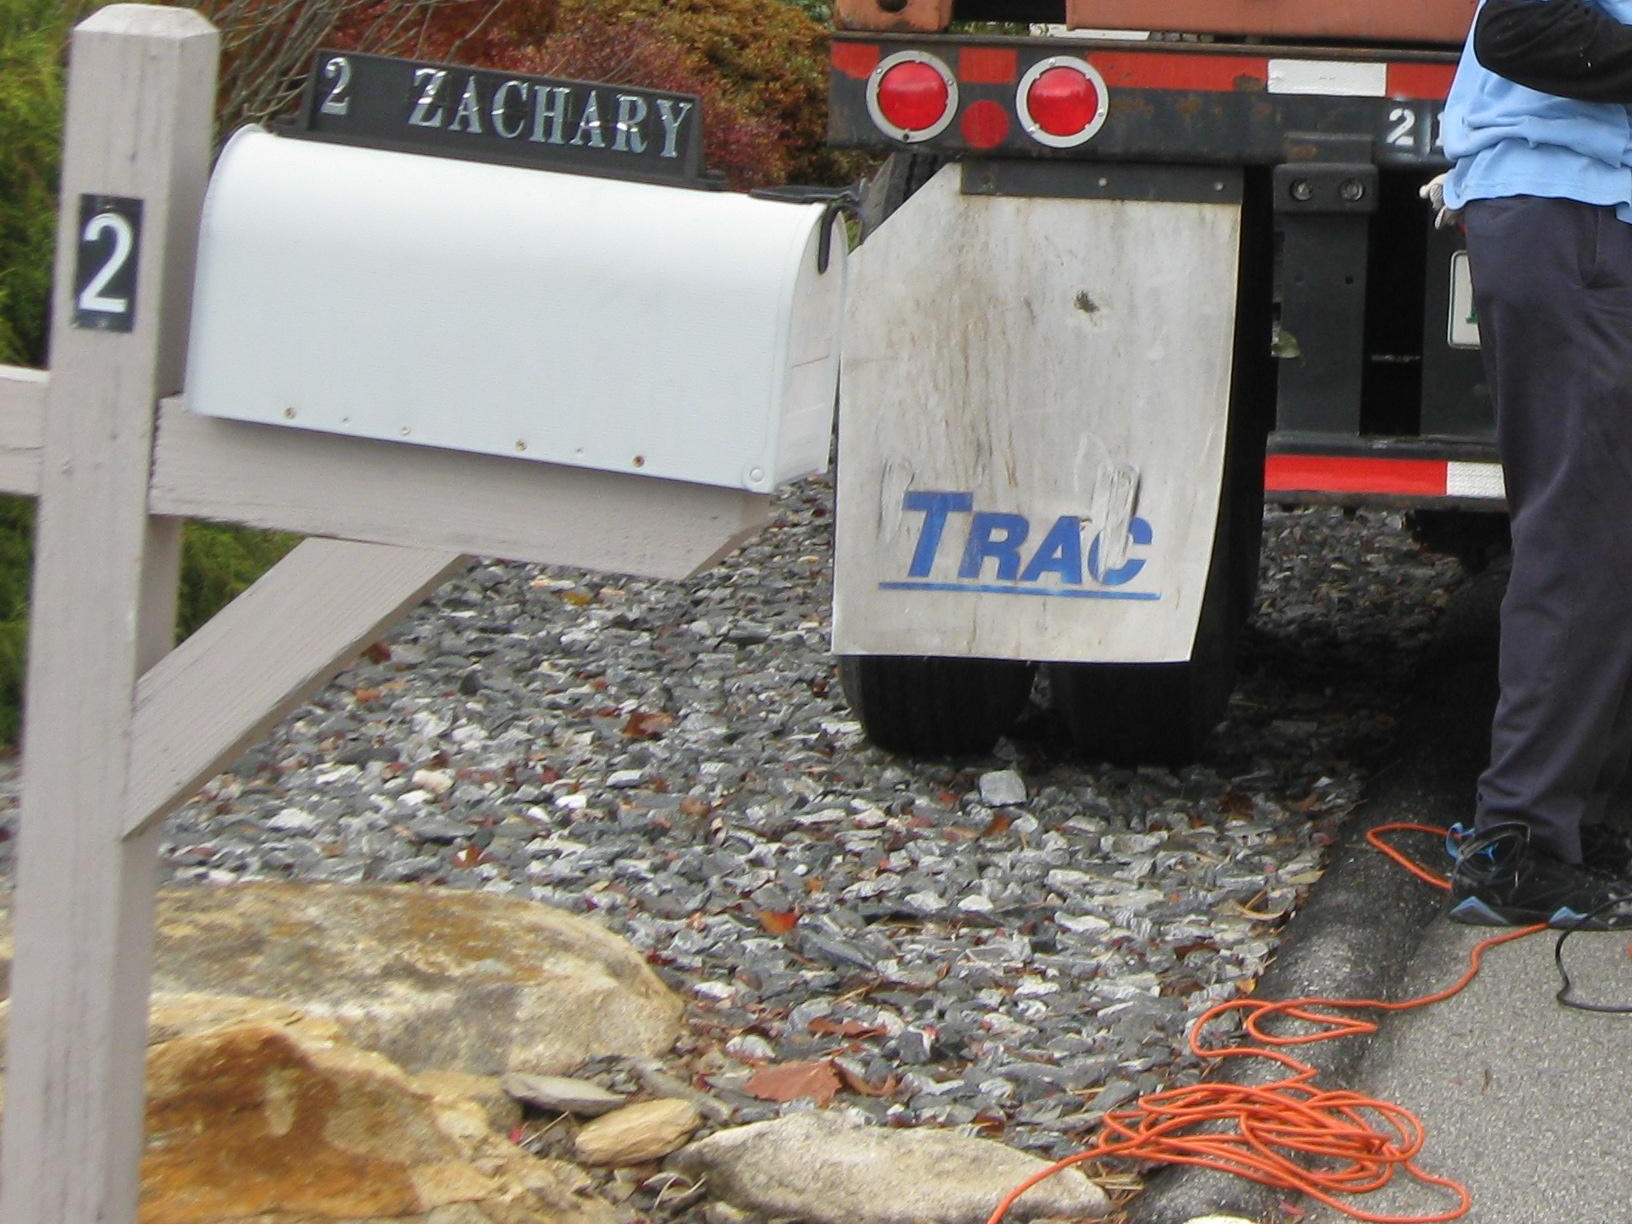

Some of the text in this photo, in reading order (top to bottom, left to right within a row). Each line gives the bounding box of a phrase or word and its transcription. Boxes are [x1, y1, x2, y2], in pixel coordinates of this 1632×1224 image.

[320, 56, 693, 158] 2 ZACHARY
[79, 213, 132, 313] 2
[902, 490, 1153, 586] TRAC
